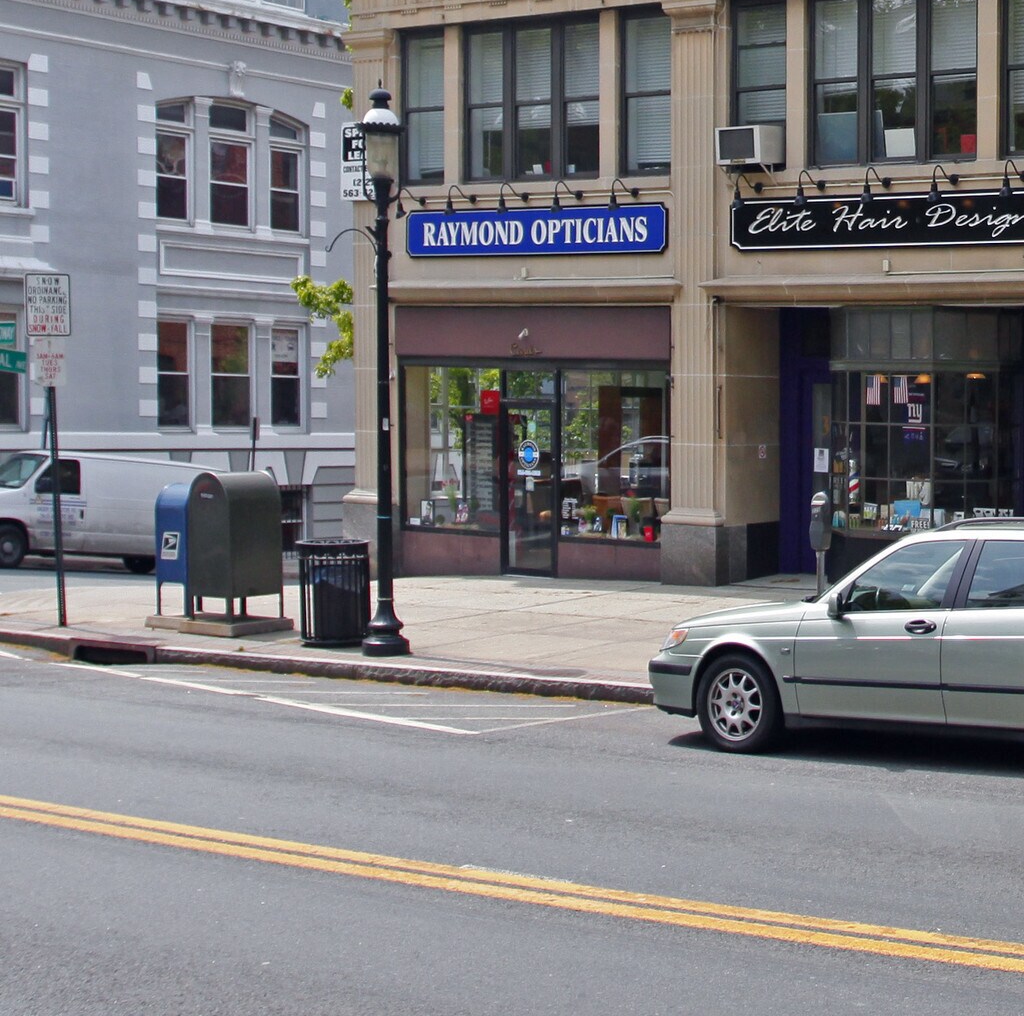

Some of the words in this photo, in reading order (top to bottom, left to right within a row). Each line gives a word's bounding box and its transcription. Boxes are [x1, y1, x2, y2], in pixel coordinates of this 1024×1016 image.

[748, 207, 816, 234] Elite
[831, 203, 908, 233] Hair
[422, 220, 524, 246] RAYMOND
[530, 216, 648, 246] OPTICIANS
[36, 277, 60, 285] SNOW
[28, 296, 37, 304] NO
[39, 296, 68, 304] PARKING
[30, 305, 46, 314] THIS
[51, 305, 67, 314] SIDE
[33, 314, 65, 324] DURING
